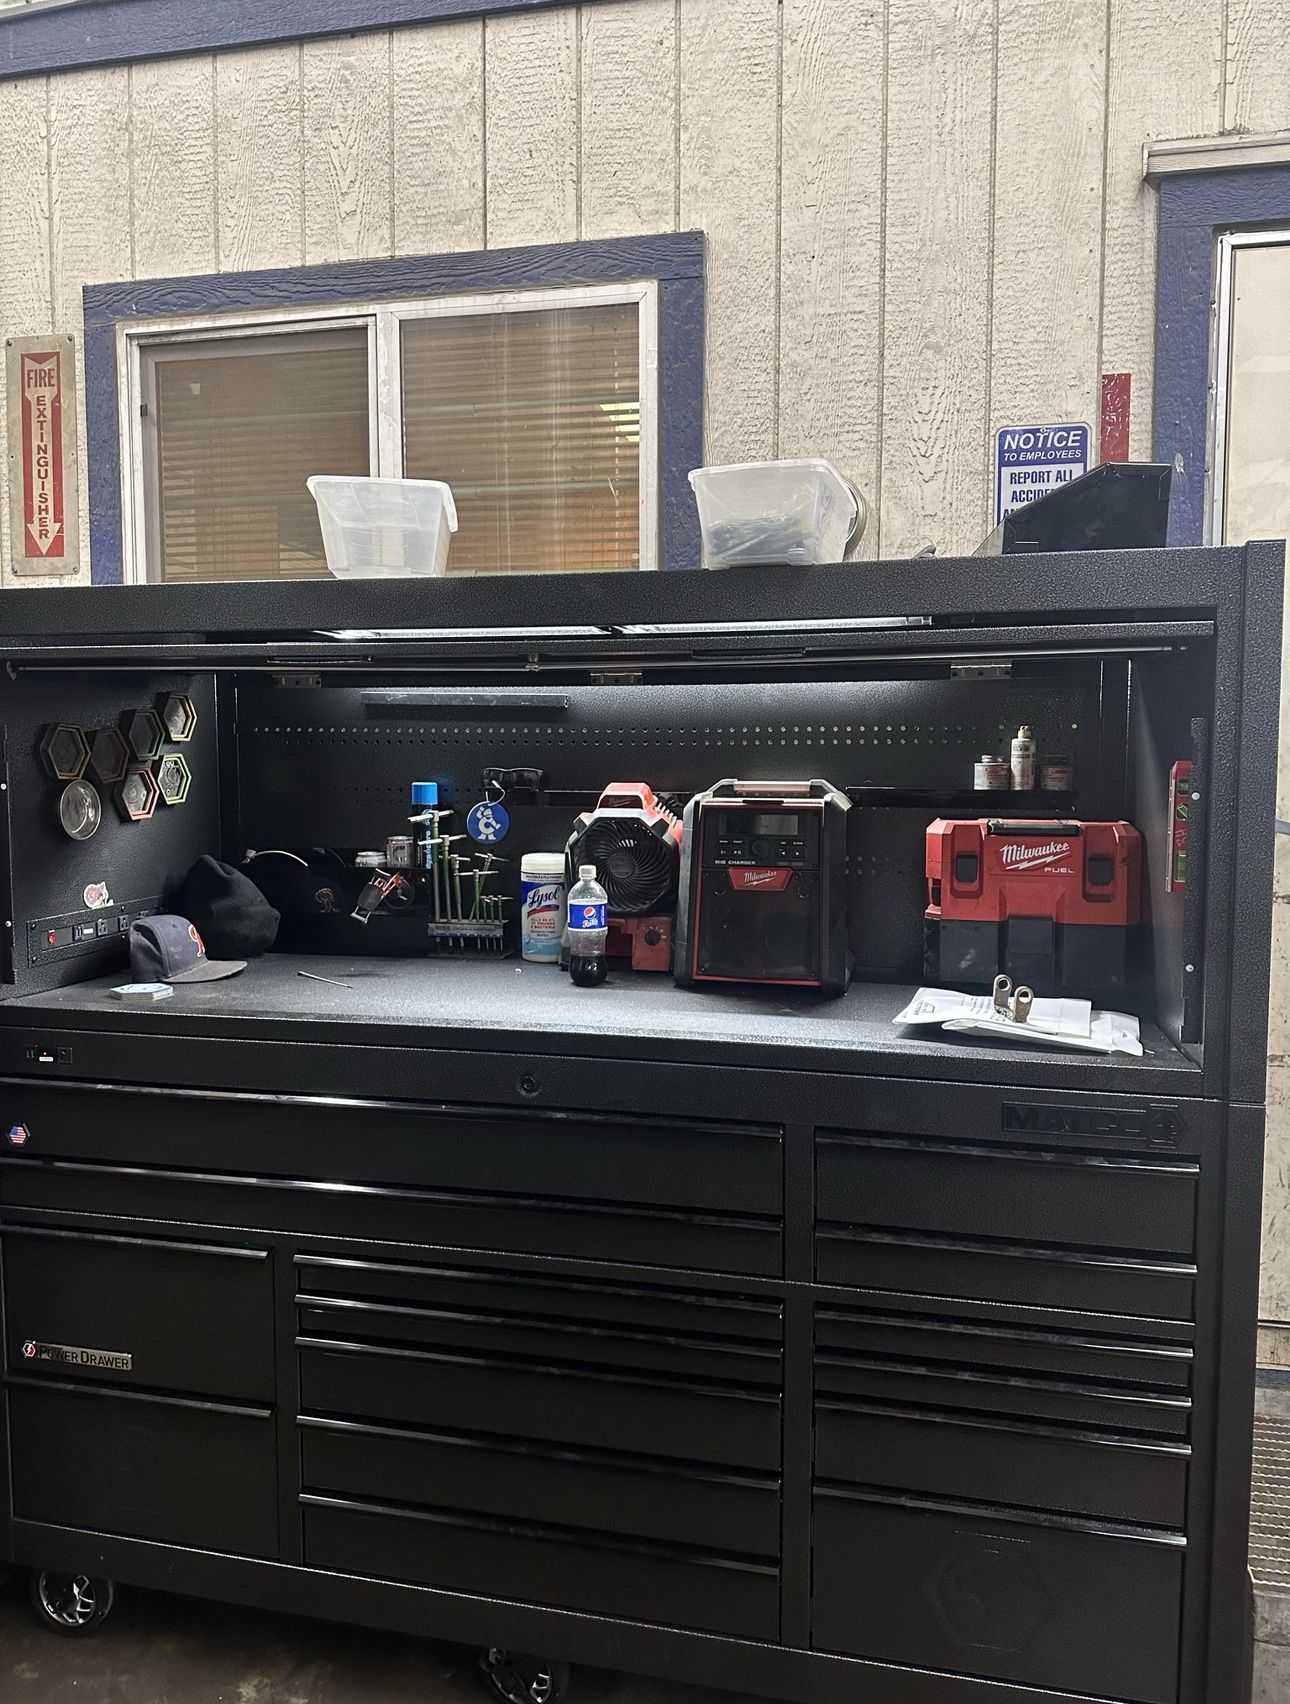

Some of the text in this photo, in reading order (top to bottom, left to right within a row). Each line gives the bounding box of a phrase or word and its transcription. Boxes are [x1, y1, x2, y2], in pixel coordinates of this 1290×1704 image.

[27, 368, 55, 389] FIRE
[1003, 431, 1082, 450] NOTICE
[1004, 449, 1082, 461] TO EMPLOYEES
[36, 395, 50, 539] EXTINGUISHER
[1010, 470, 1052, 484] REPORT
[1000, 842, 1070, 864] Milwaukee
[744, 870, 777, 882] Milwaukee
[528, 886, 560, 908] Lysol
[40, 1346, 129, 1369] POWER DRAWER
